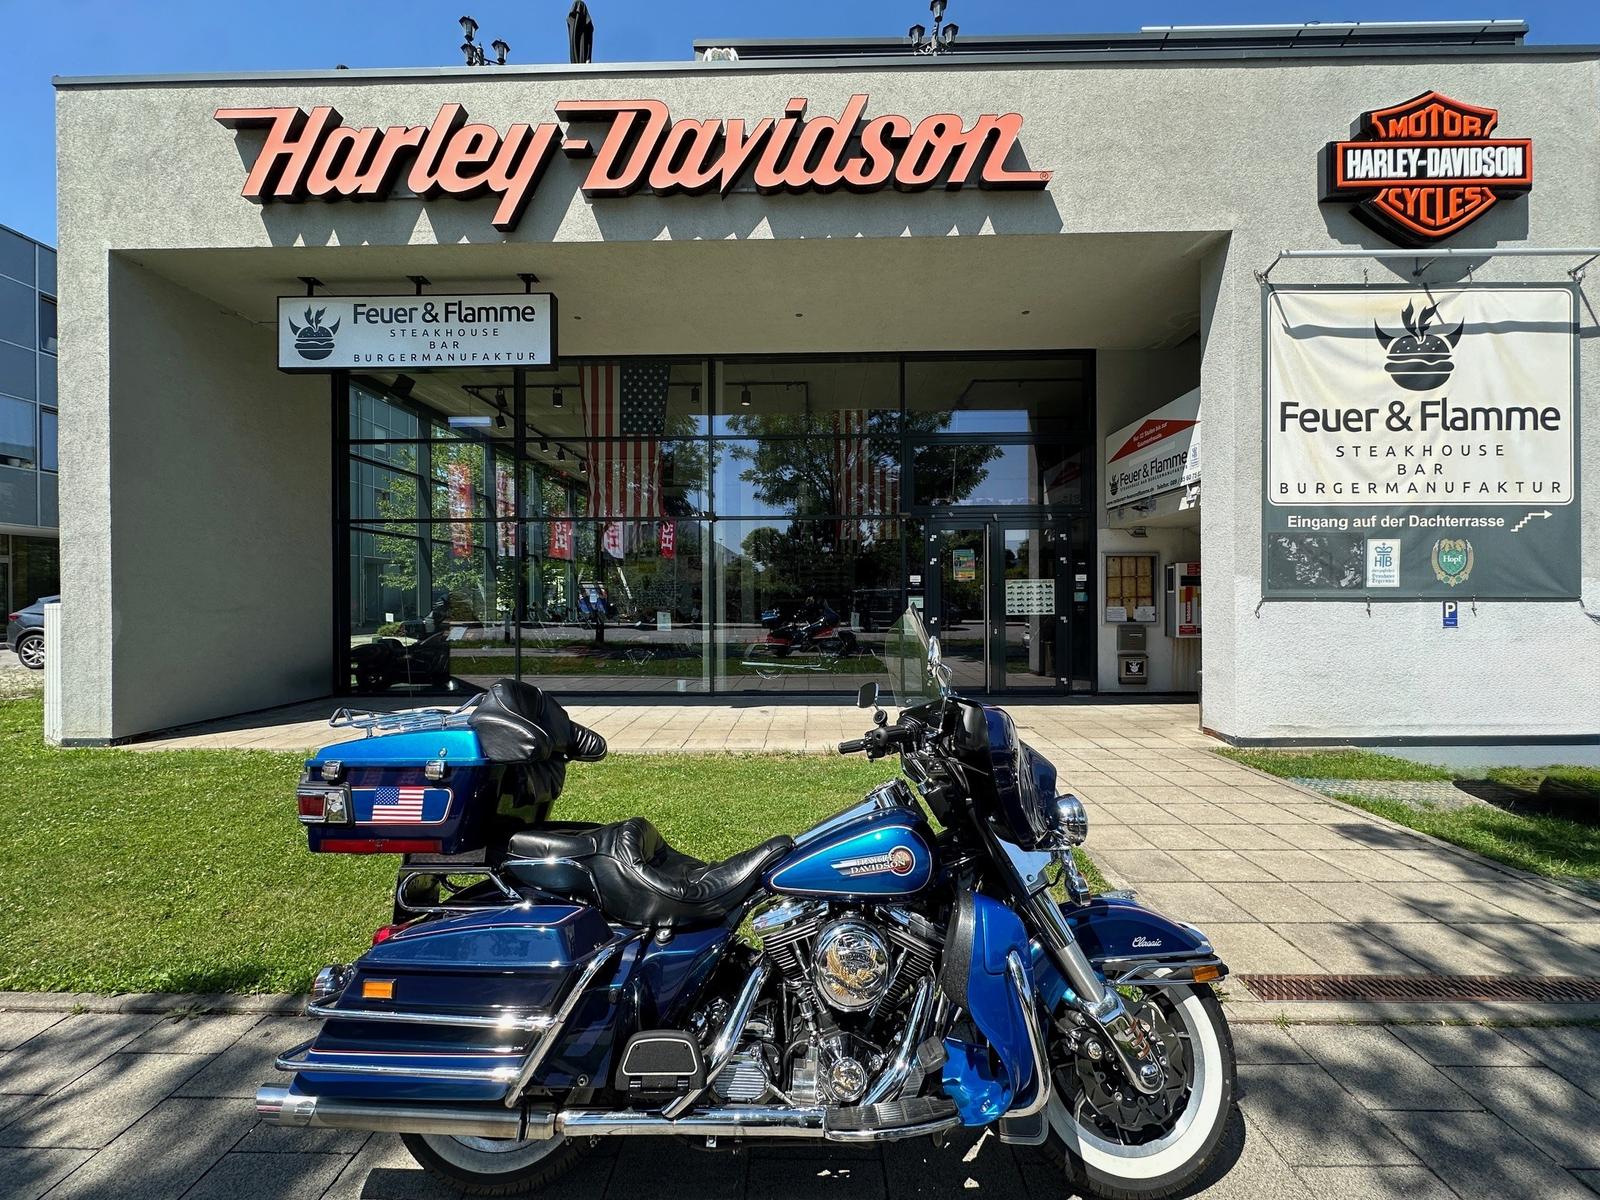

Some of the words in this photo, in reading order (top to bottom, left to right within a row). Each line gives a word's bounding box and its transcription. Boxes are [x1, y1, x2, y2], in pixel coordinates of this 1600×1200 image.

[1388, 102, 1482, 138] MOTOR
[213, 94, 1054, 228] Harley-Davidson
[1346, 146, 1523, 179] HARLEY-DAVIDSON
[1388, 186, 1483, 227] CYCLES
[353, 303, 418, 324] Feuer
[421, 301, 439, 323] &
[444, 300, 536, 323] Flamme
[389, 327, 500, 338] STEAKHOUSE
[429, 340, 460, 349] BAR
[353, 352, 536, 363] BURGERMANUFAKTUR
[1279, 401, 1379, 433] Feuer
[1385, 400, 1413, 432] &
[1420, 397, 1562, 432] Flamme
[1335, 444, 1505, 458] STEAKHOUSE
[1119, 467, 1141, 487] Feuer
[1142, 463, 1150, 479] &
[1150, 451, 1188, 476] Flamme
[1397, 463, 1444, 475] BAR
[1279, 481, 1562, 495] BURGERMANUFAKTUR
[1287, 515, 1348, 530] Eingang
[1352, 515, 1377, 528] auf
[1380, 514, 1405, 528] der
[1409, 514, 1505, 528] Dachterrasse
[1443, 554, 1462, 565] Hopf
[1445, 602, 1456, 618] P
[850, 859, 906, 875] DAVIDSON
[1132, 936, 1162, 948] Classic
